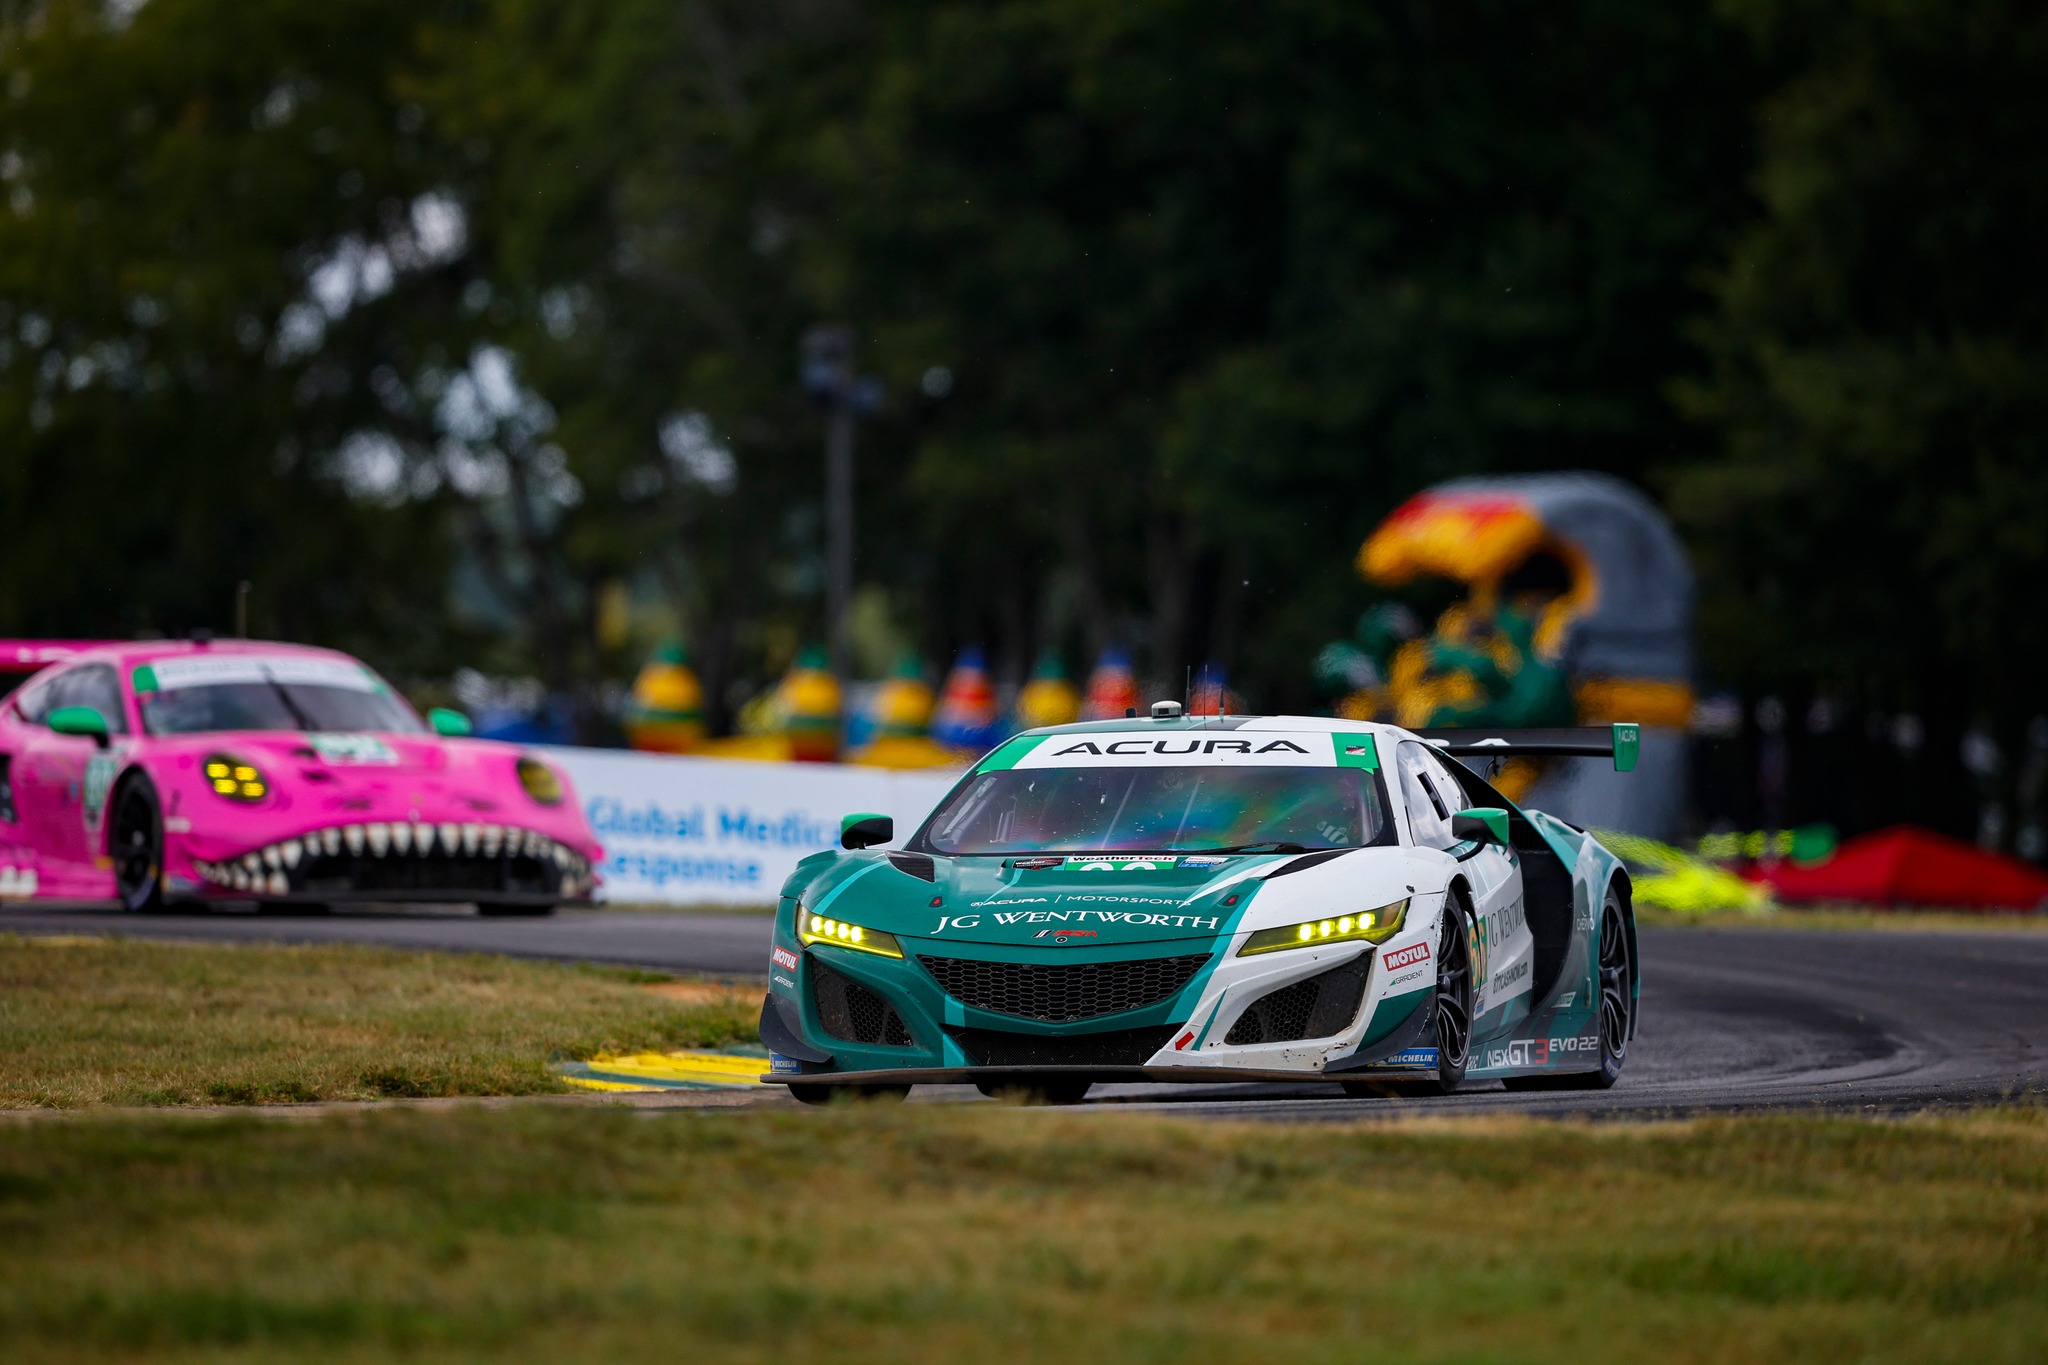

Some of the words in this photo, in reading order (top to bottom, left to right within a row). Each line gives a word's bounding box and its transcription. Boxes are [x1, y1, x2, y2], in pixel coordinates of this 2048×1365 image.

[1050, 739, 1310, 756] ACURA
[587, 797, 704, 838] Global
[983, 897, 1047, 906] ACURA
[1066, 895, 1192, 906] MOTORSPORTS
[930, 914, 980, 934] JG
[993, 910, 1219, 930] WENTWORTH
[773, 948, 797, 969] MOTUL
[1388, 945, 1428, 969] MOTUL
[1395, 969, 1423, 984] GRADIENT
[1388, 1054, 1434, 1063] MICHELIN
